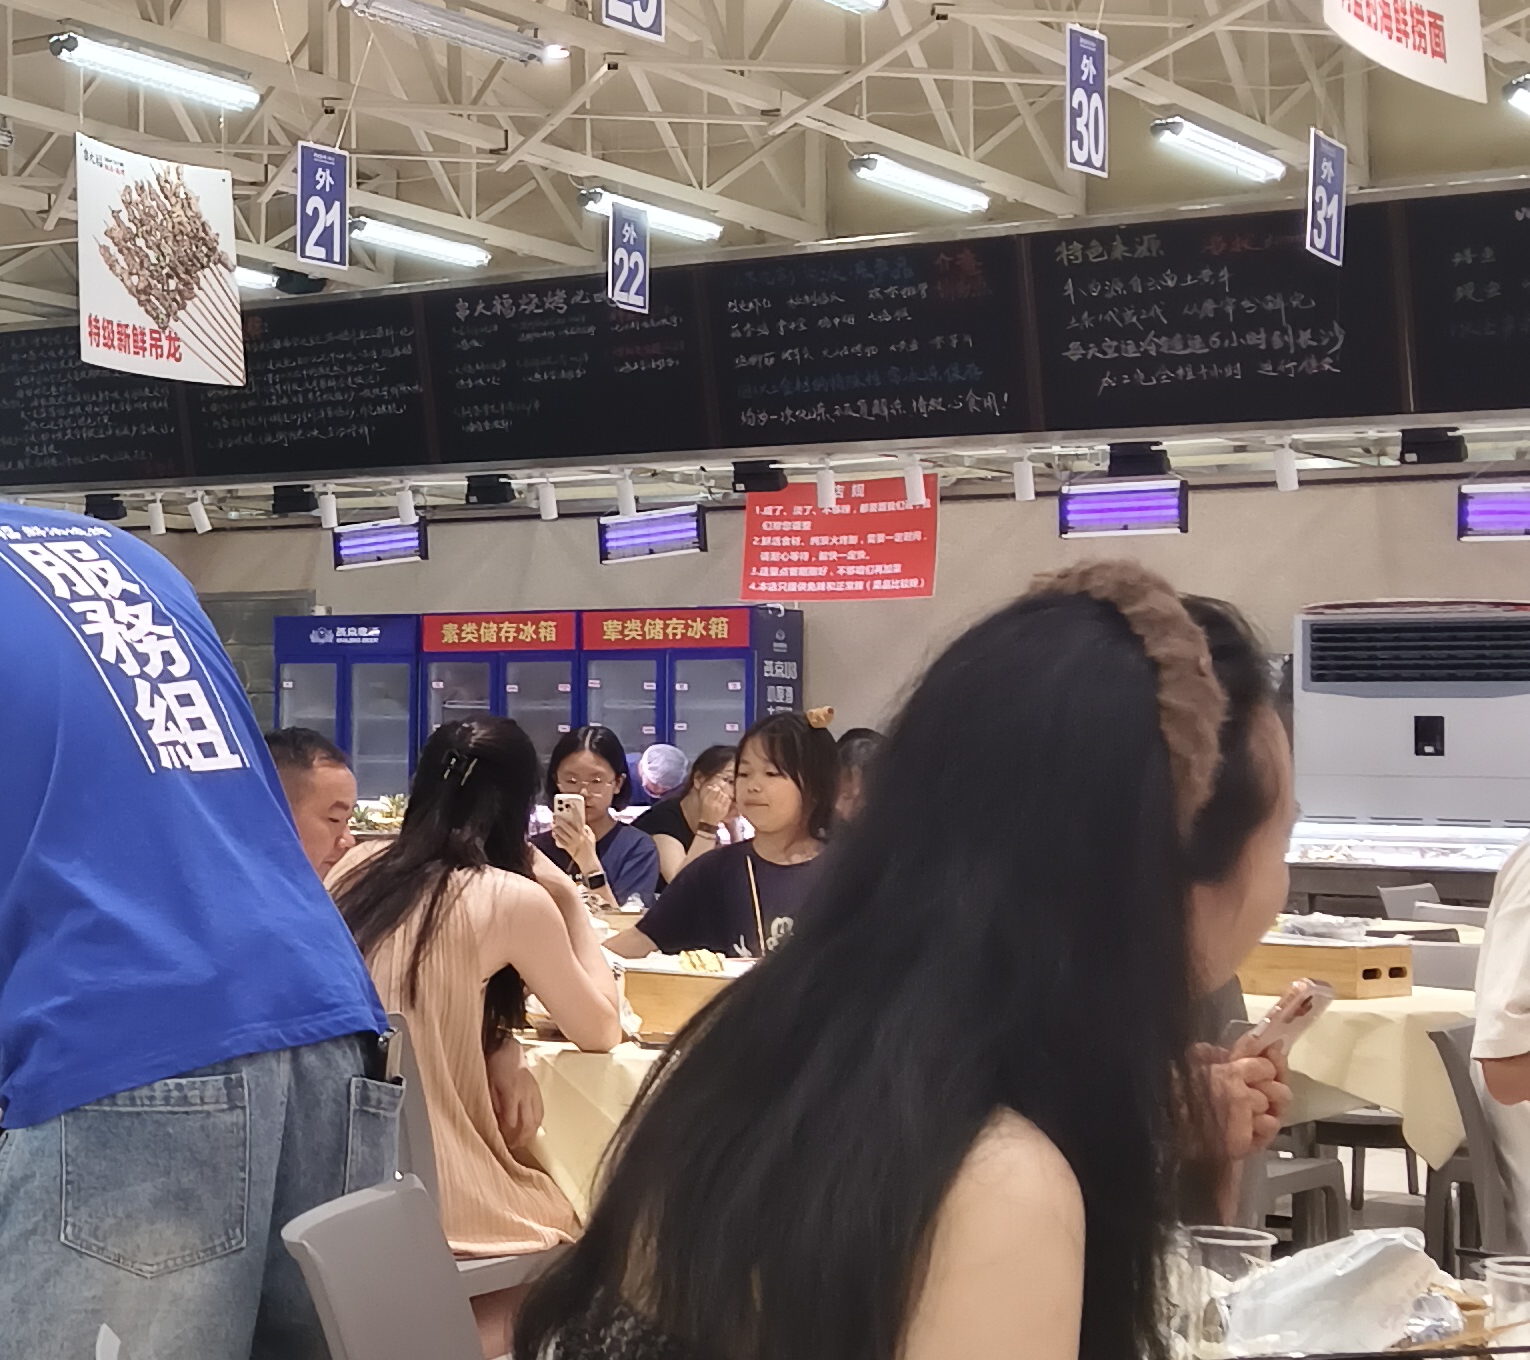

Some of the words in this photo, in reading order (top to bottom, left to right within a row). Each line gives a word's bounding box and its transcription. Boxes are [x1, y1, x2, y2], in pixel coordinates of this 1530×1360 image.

[1081, 54, 1097, 84] 外
[1072, 87, 1105, 168] 30
[315, 167, 335, 192] 外
[1321, 157, 1335, 184] 外
[305, 195, 341, 262] 21
[622, 222, 638, 245] 外
[1313, 185, 1339, 257] 31
[614, 247, 645, 307] 22
[86, 313, 183, 363] 特级新鲜吊龙
[441, 620, 558, 644] 素类储存冰箱
[602, 616, 730, 642] 荤类储存冰箱
[9, 541, 243, 772] 服務組
